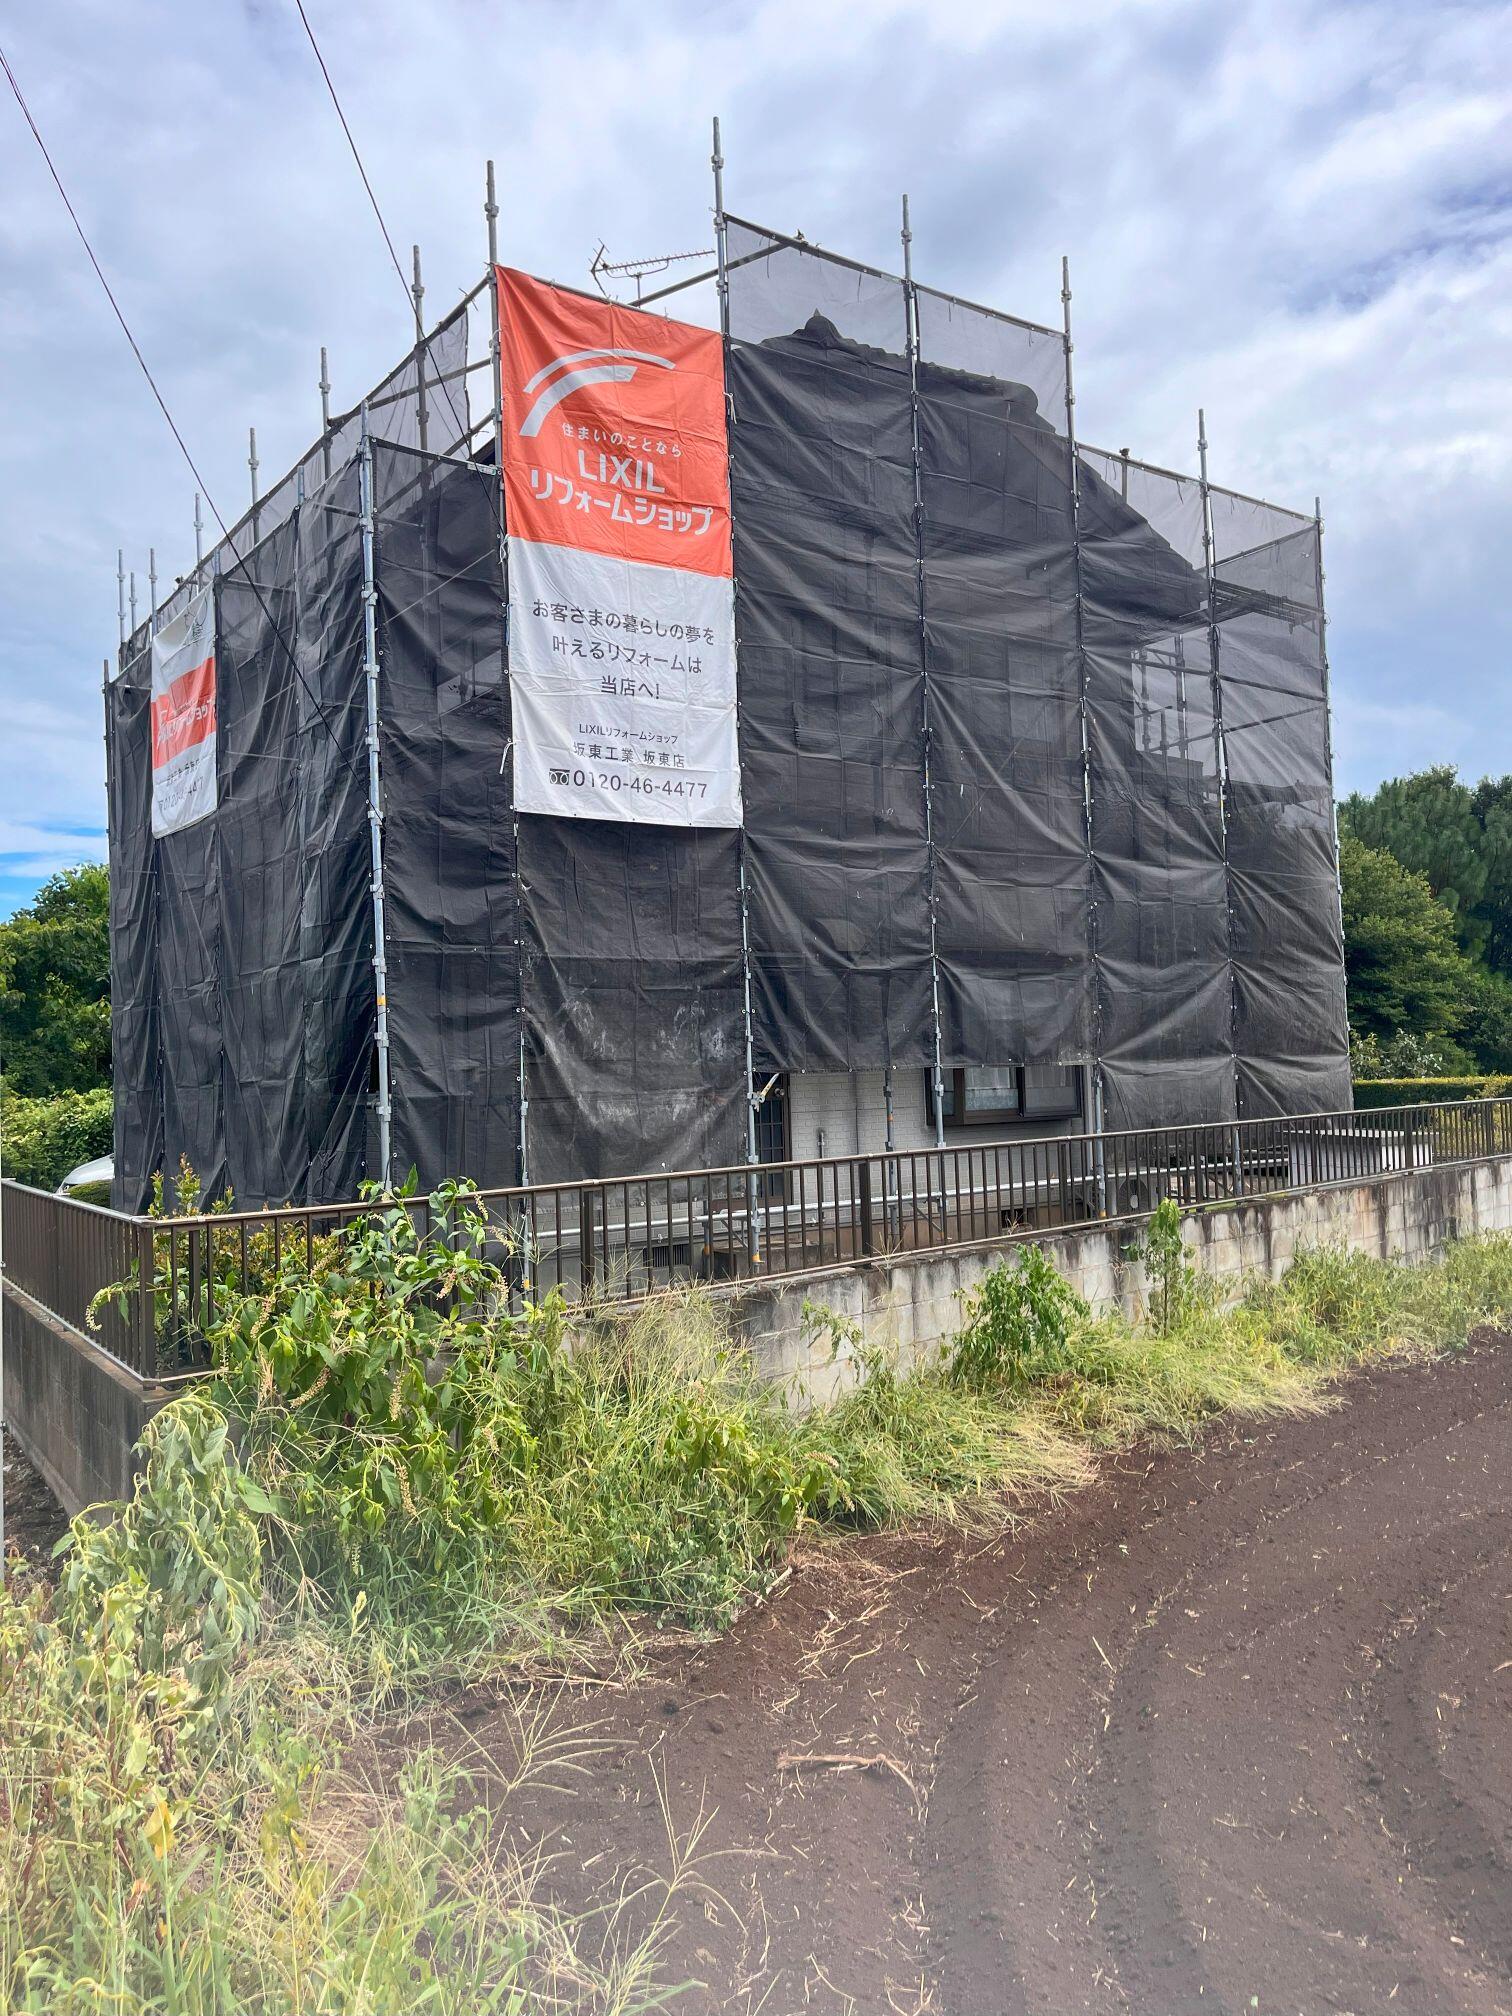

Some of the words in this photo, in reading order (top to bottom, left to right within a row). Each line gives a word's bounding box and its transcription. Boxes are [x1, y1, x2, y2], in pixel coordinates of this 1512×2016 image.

[561, 422, 682, 457] 住まいのことなら
[578, 449, 665, 493] LIXIL
[531, 469, 714, 535] リフォームショップ
[532, 599, 714, 646] お客さまの暮らしの夢を
[552, 635, 702, 674] 叶えるリフォームは
[573, 741, 634, 763] 坂東工業
[643, 749, 685, 768] 坂東店
[573, 769, 707, 798] 0120-46-4477
